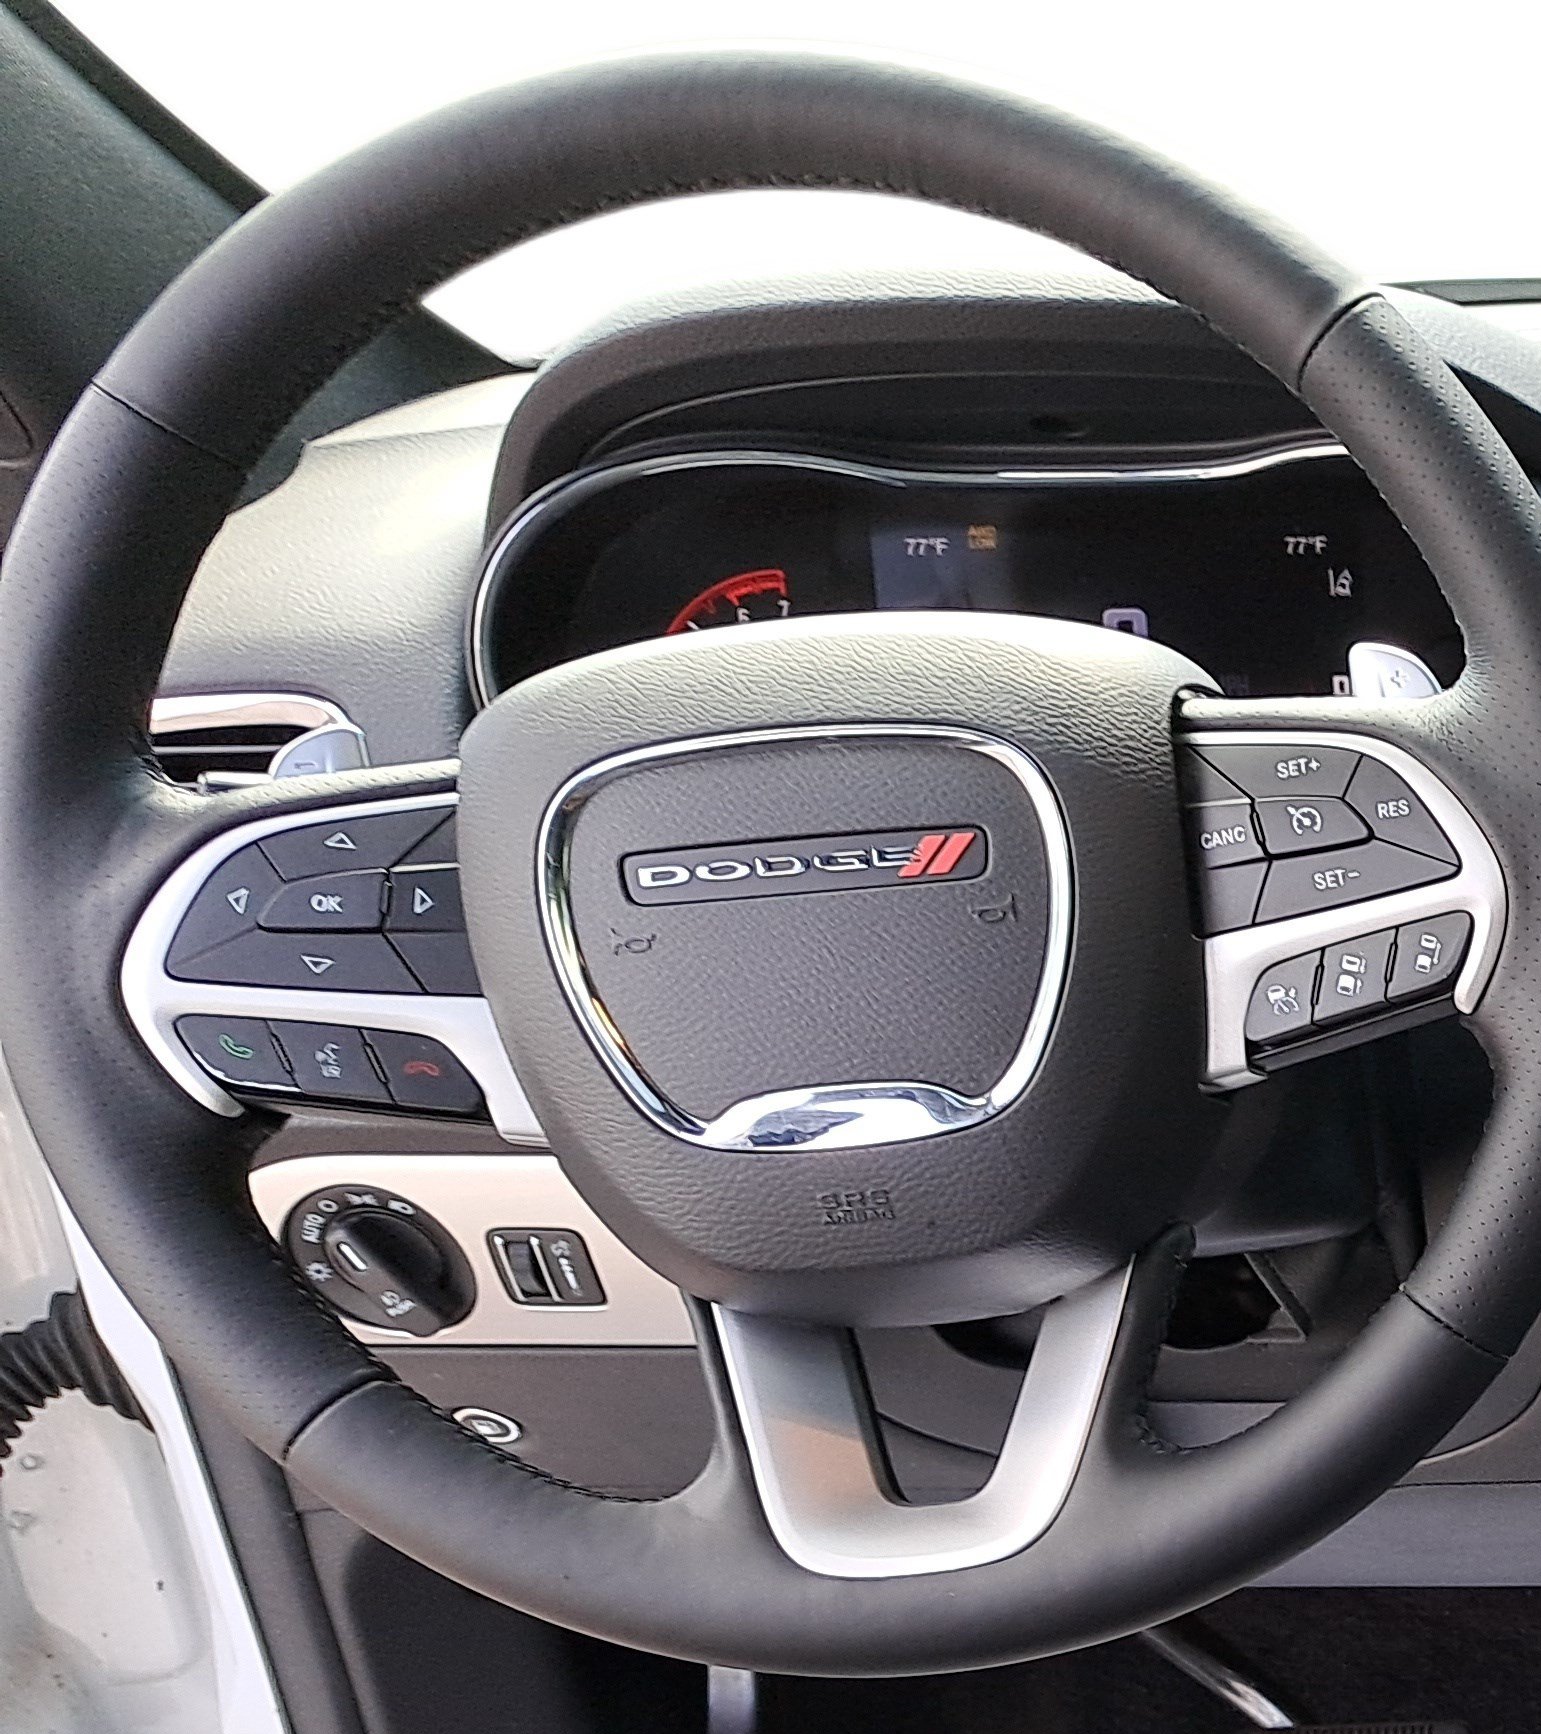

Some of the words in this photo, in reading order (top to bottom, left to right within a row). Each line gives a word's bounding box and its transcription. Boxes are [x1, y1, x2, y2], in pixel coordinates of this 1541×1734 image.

[1377, 799, 1410, 819] RES
[637, 845, 921, 888] DODGE
[309, 893, 344, 913] OK
[301, 1212, 327, 1244] AUTO
